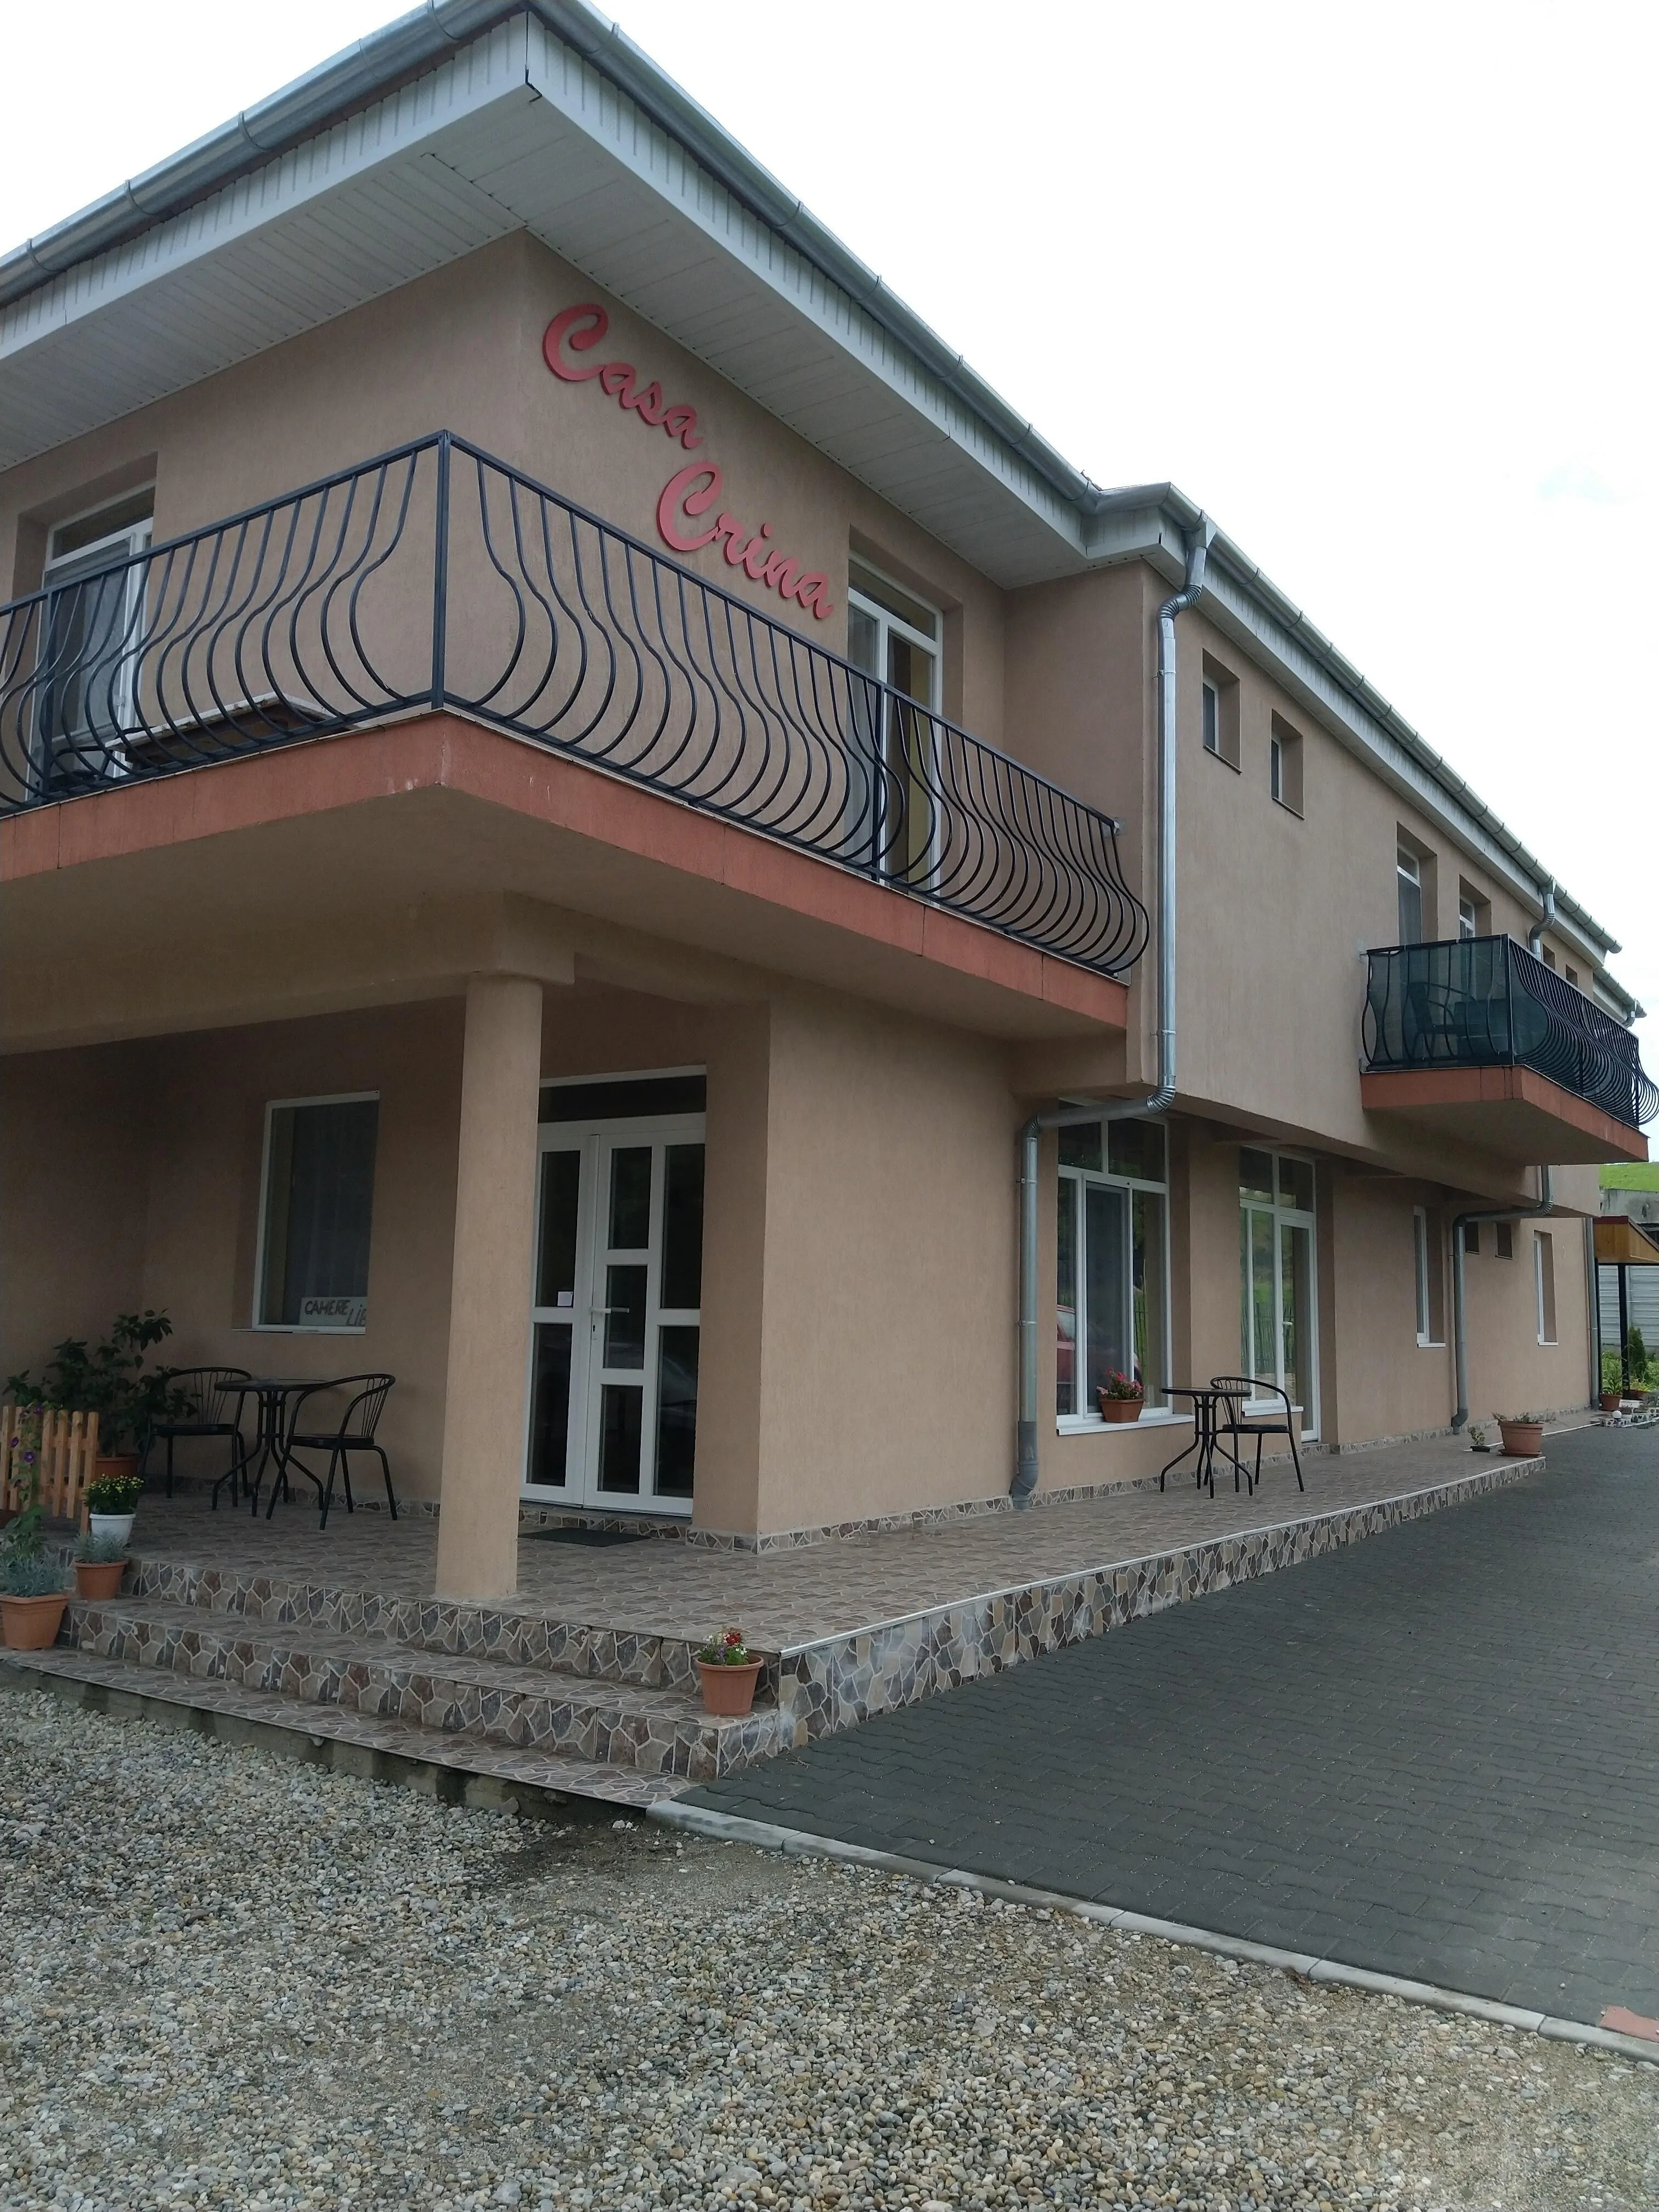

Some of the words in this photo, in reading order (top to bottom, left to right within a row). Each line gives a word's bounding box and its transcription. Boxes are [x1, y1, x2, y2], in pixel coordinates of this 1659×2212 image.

[543, 303, 704, 449] Casa
[657, 461, 834, 619] Crina
[304, 1300, 351, 1315] CAMERE
